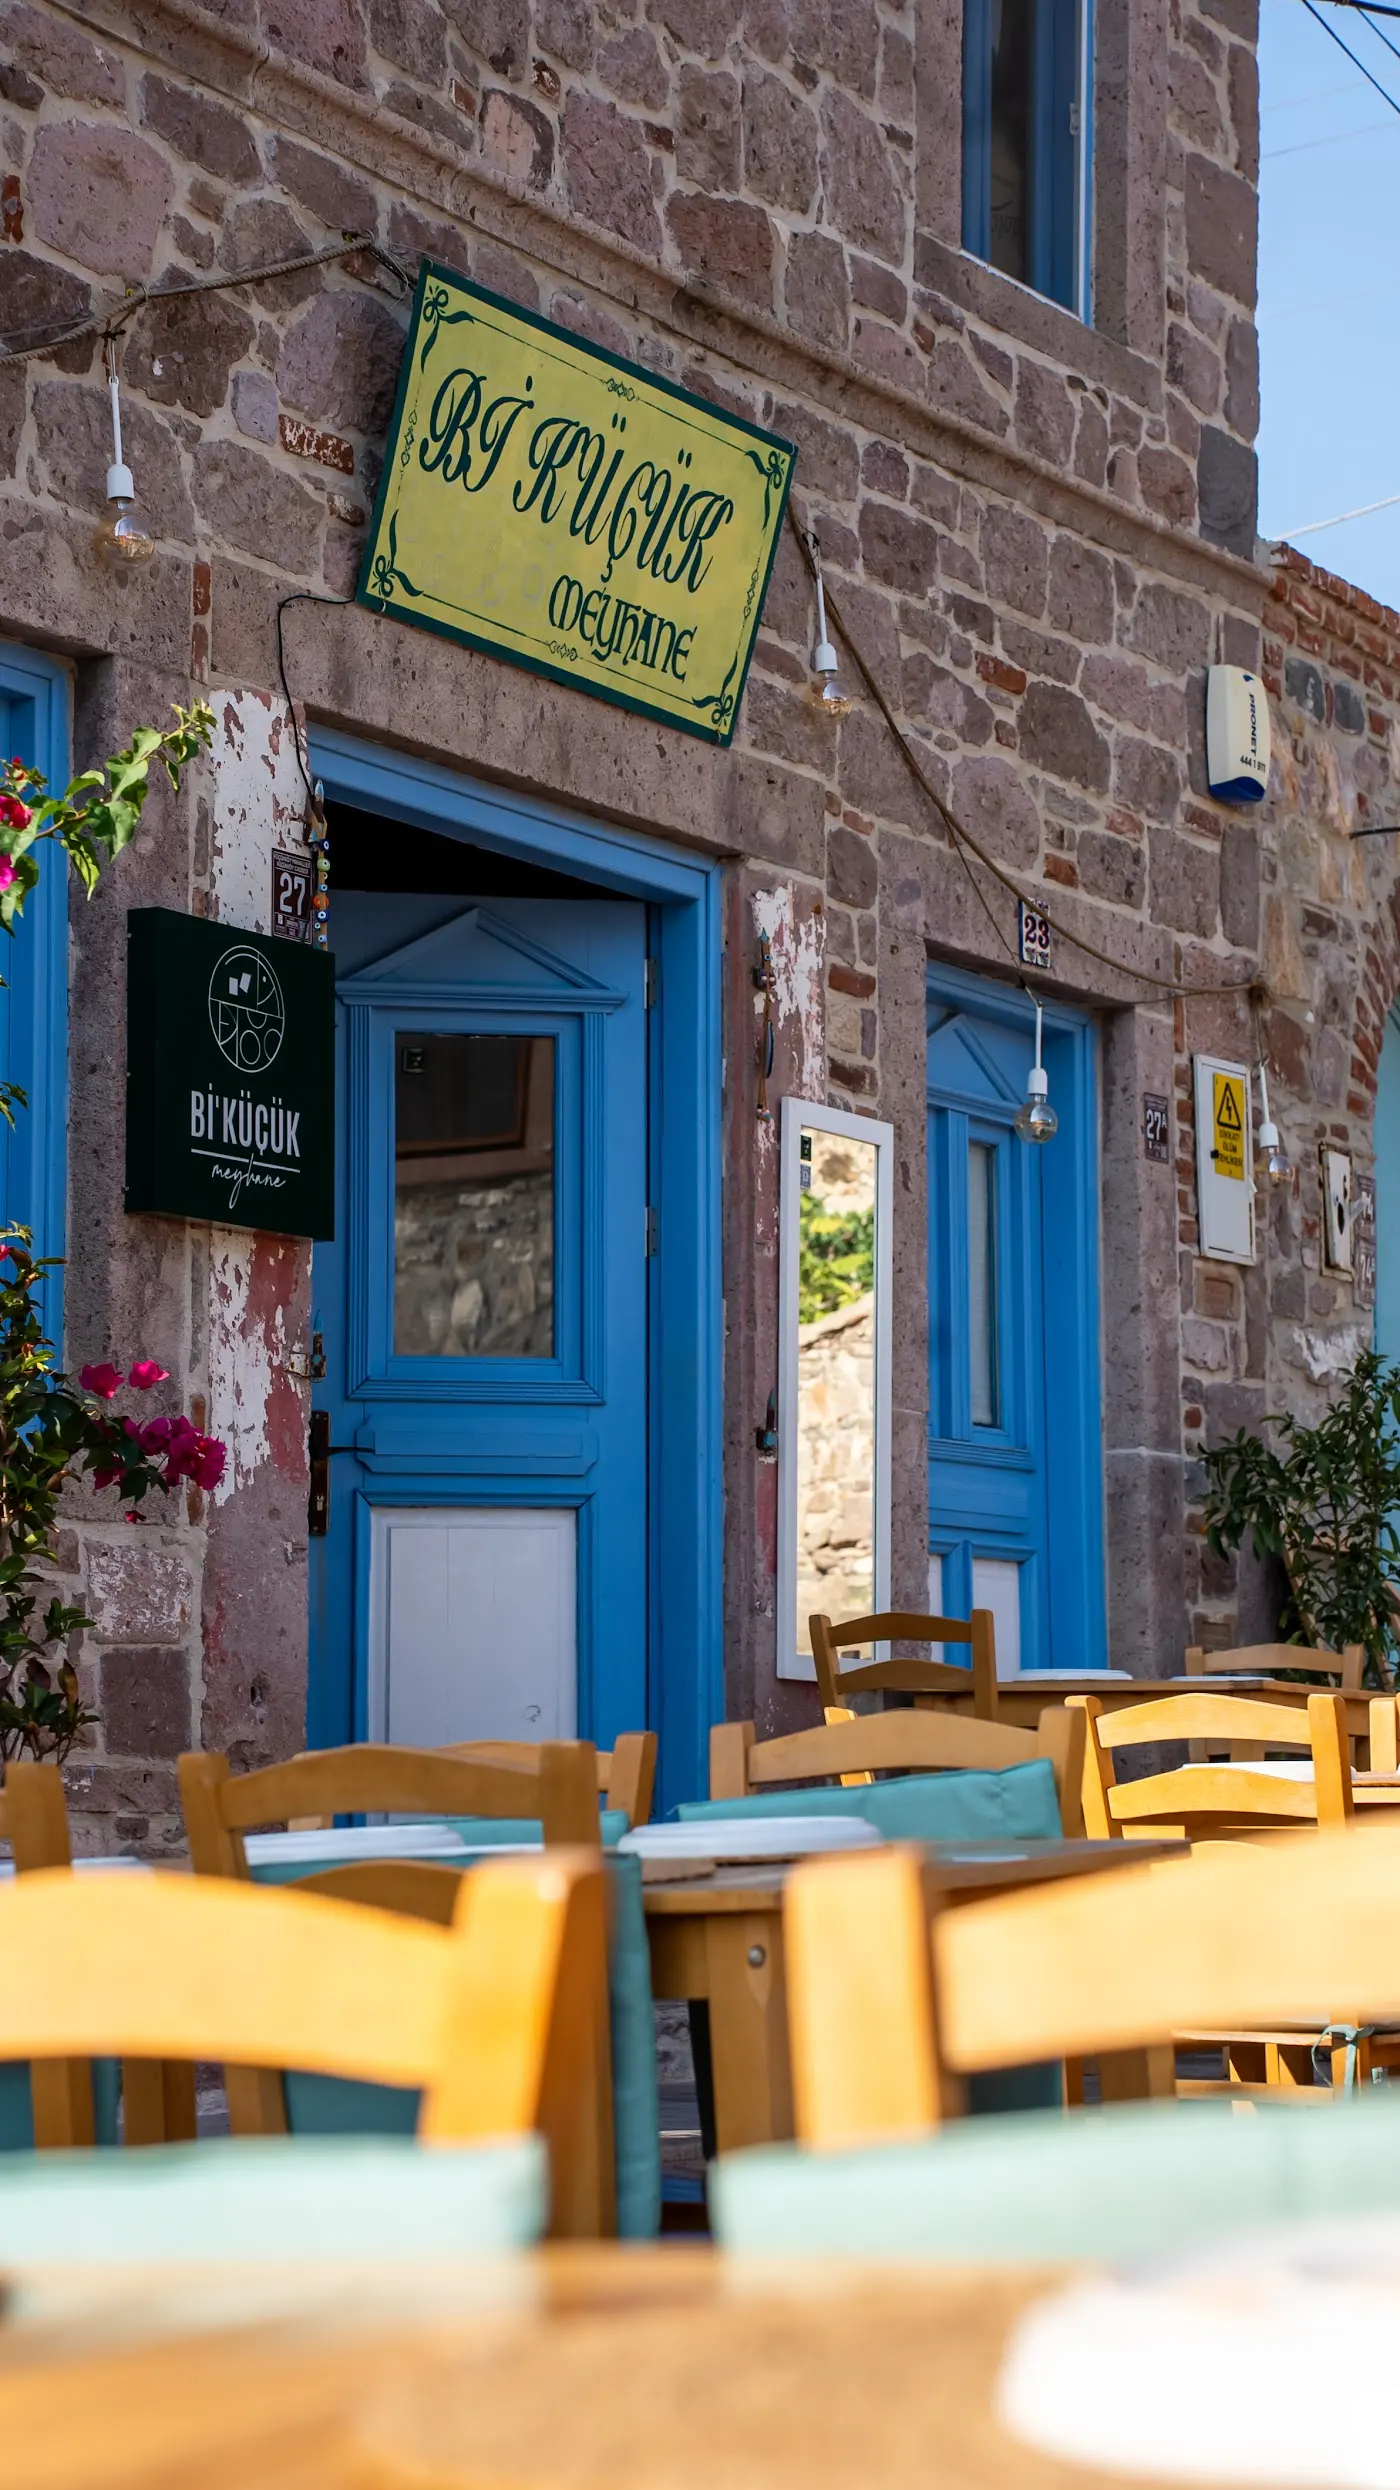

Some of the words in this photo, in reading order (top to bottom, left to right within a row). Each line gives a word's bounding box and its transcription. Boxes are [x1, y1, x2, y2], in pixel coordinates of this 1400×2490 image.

[419, 369, 536, 492] Bİ
[513, 413, 734, 593] KÜÇÜK
[1249, 693, 1257, 756] PRONET
[1240, 755, 1252, 767] 444
[280, 872, 306, 916] 27
[1024, 914, 1050, 950] 23
[211, 1153, 287, 1209] meyhane
